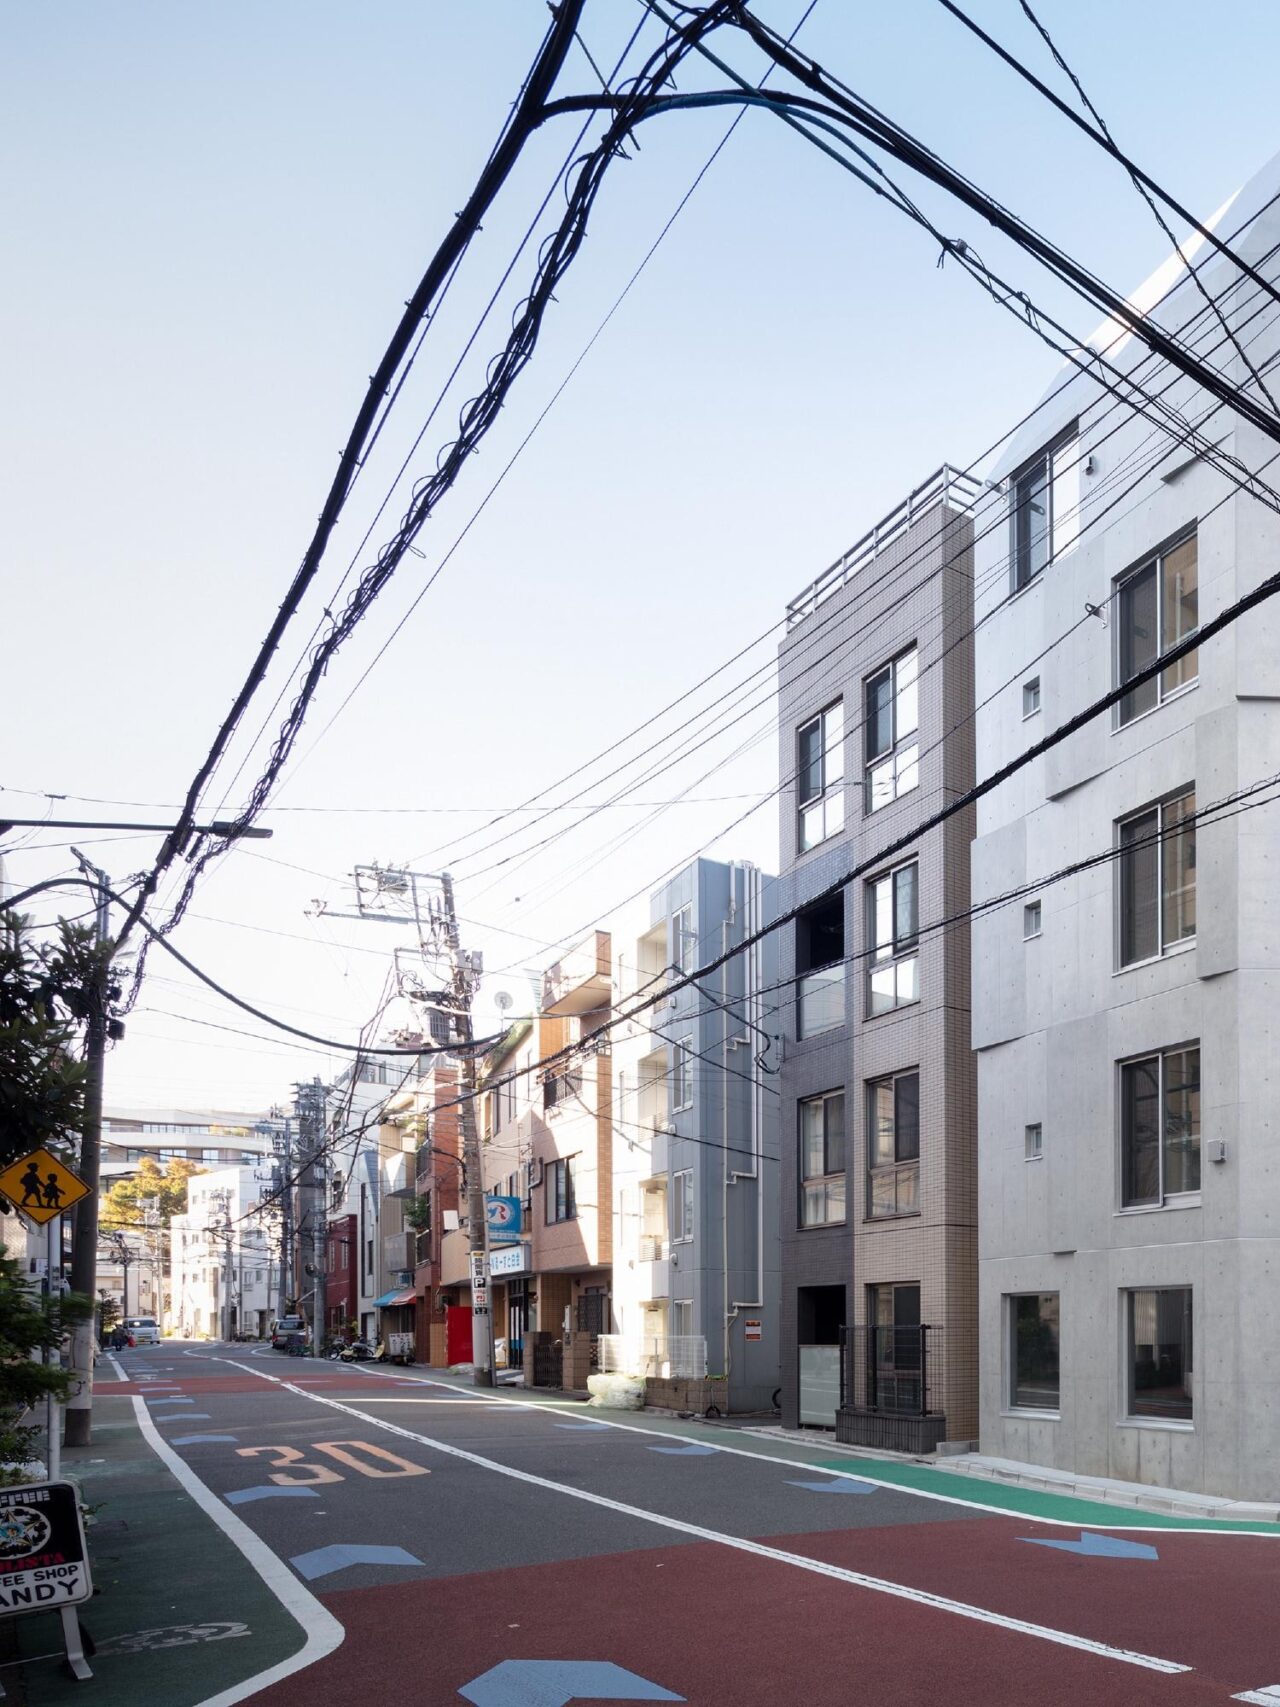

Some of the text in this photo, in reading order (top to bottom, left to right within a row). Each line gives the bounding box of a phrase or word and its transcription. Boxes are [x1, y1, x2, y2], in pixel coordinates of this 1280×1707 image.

[235, 1440, 431, 1486] 30
[0, 1565, 78, 1588] EE SHOP
